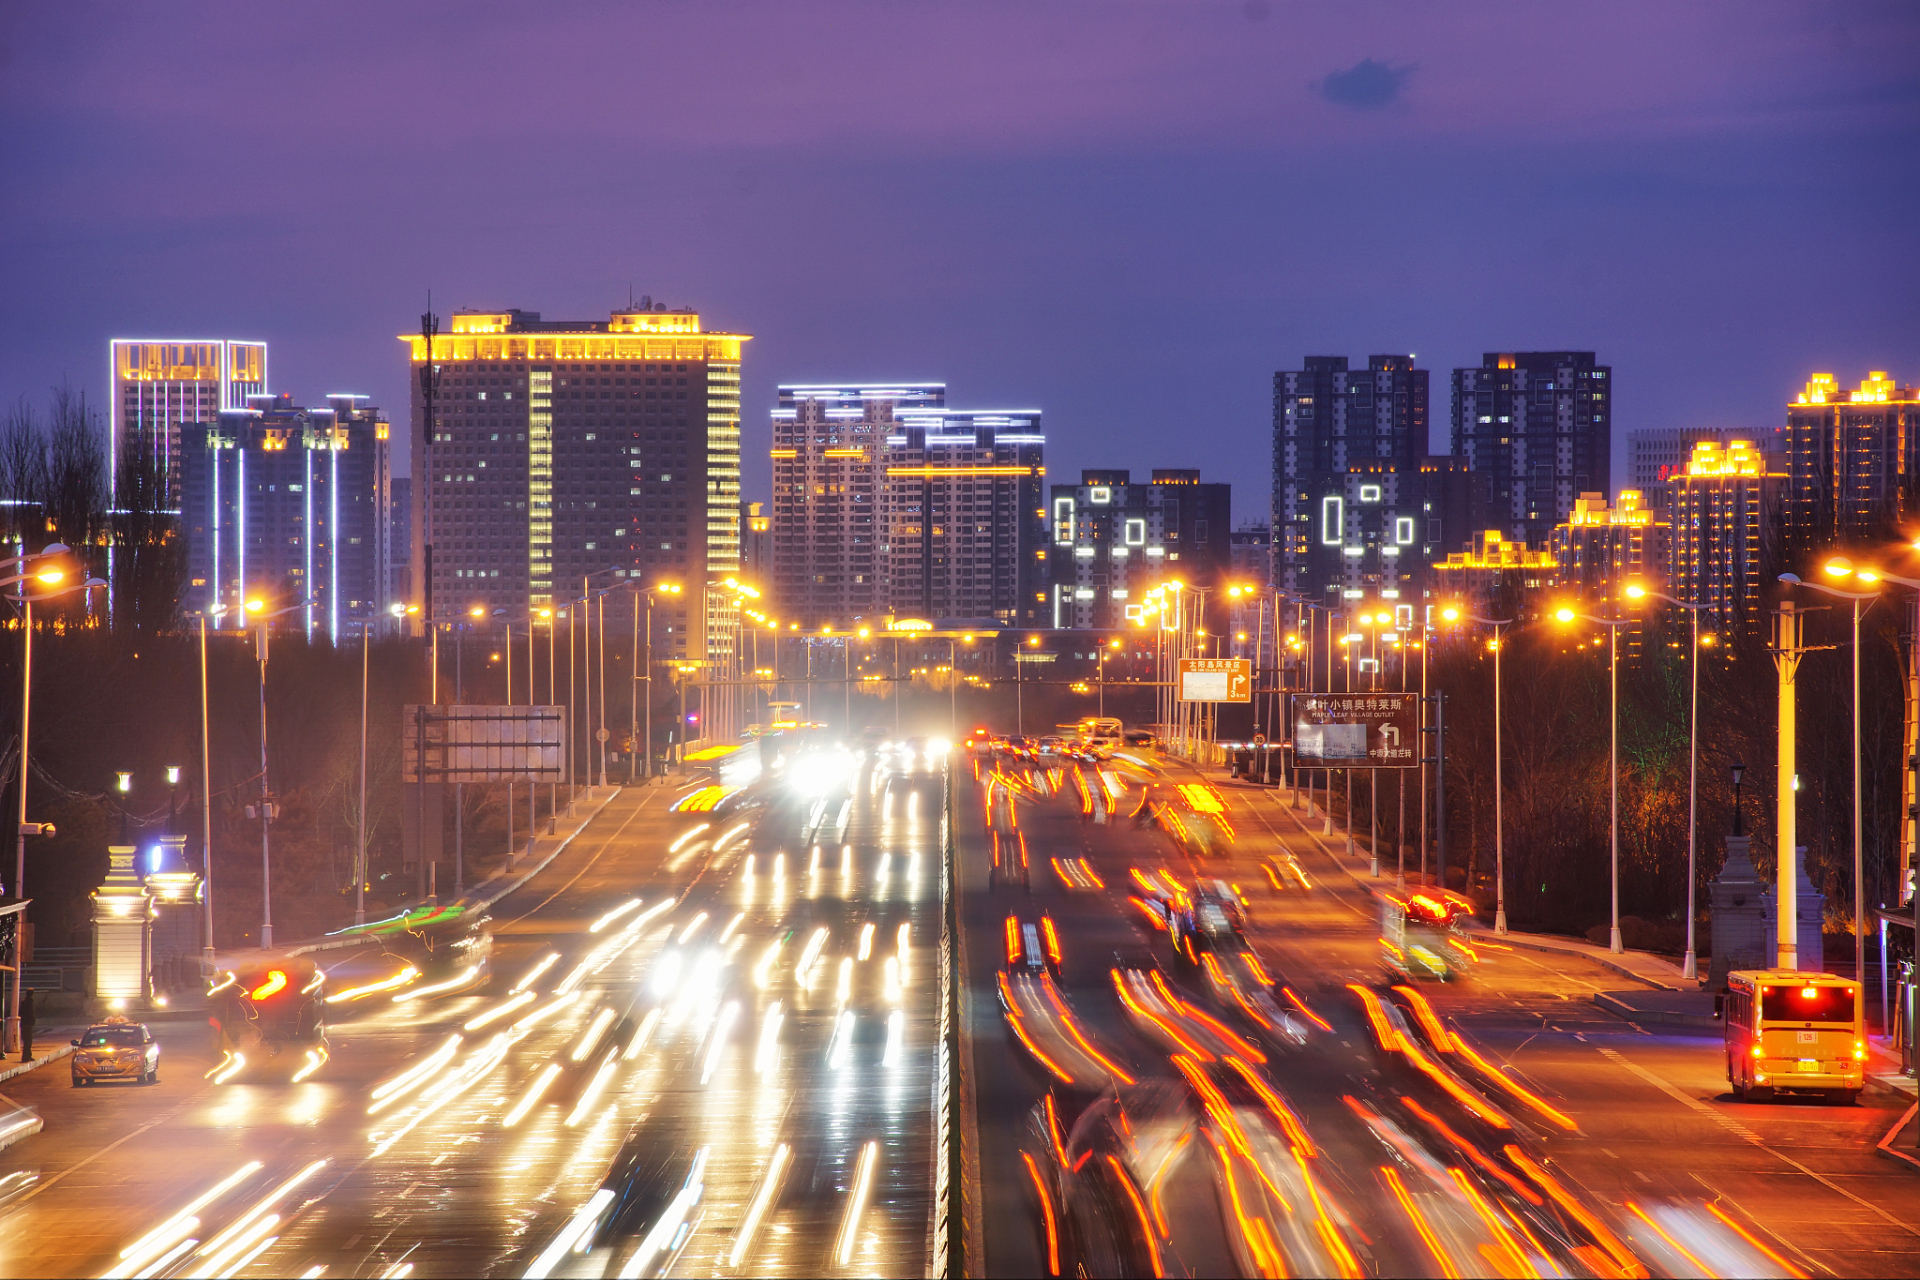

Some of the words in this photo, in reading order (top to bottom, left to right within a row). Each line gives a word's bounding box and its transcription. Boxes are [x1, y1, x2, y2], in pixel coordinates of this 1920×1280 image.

[1306, 699, 1401, 710] 枫叶小镇奥特莱斯
